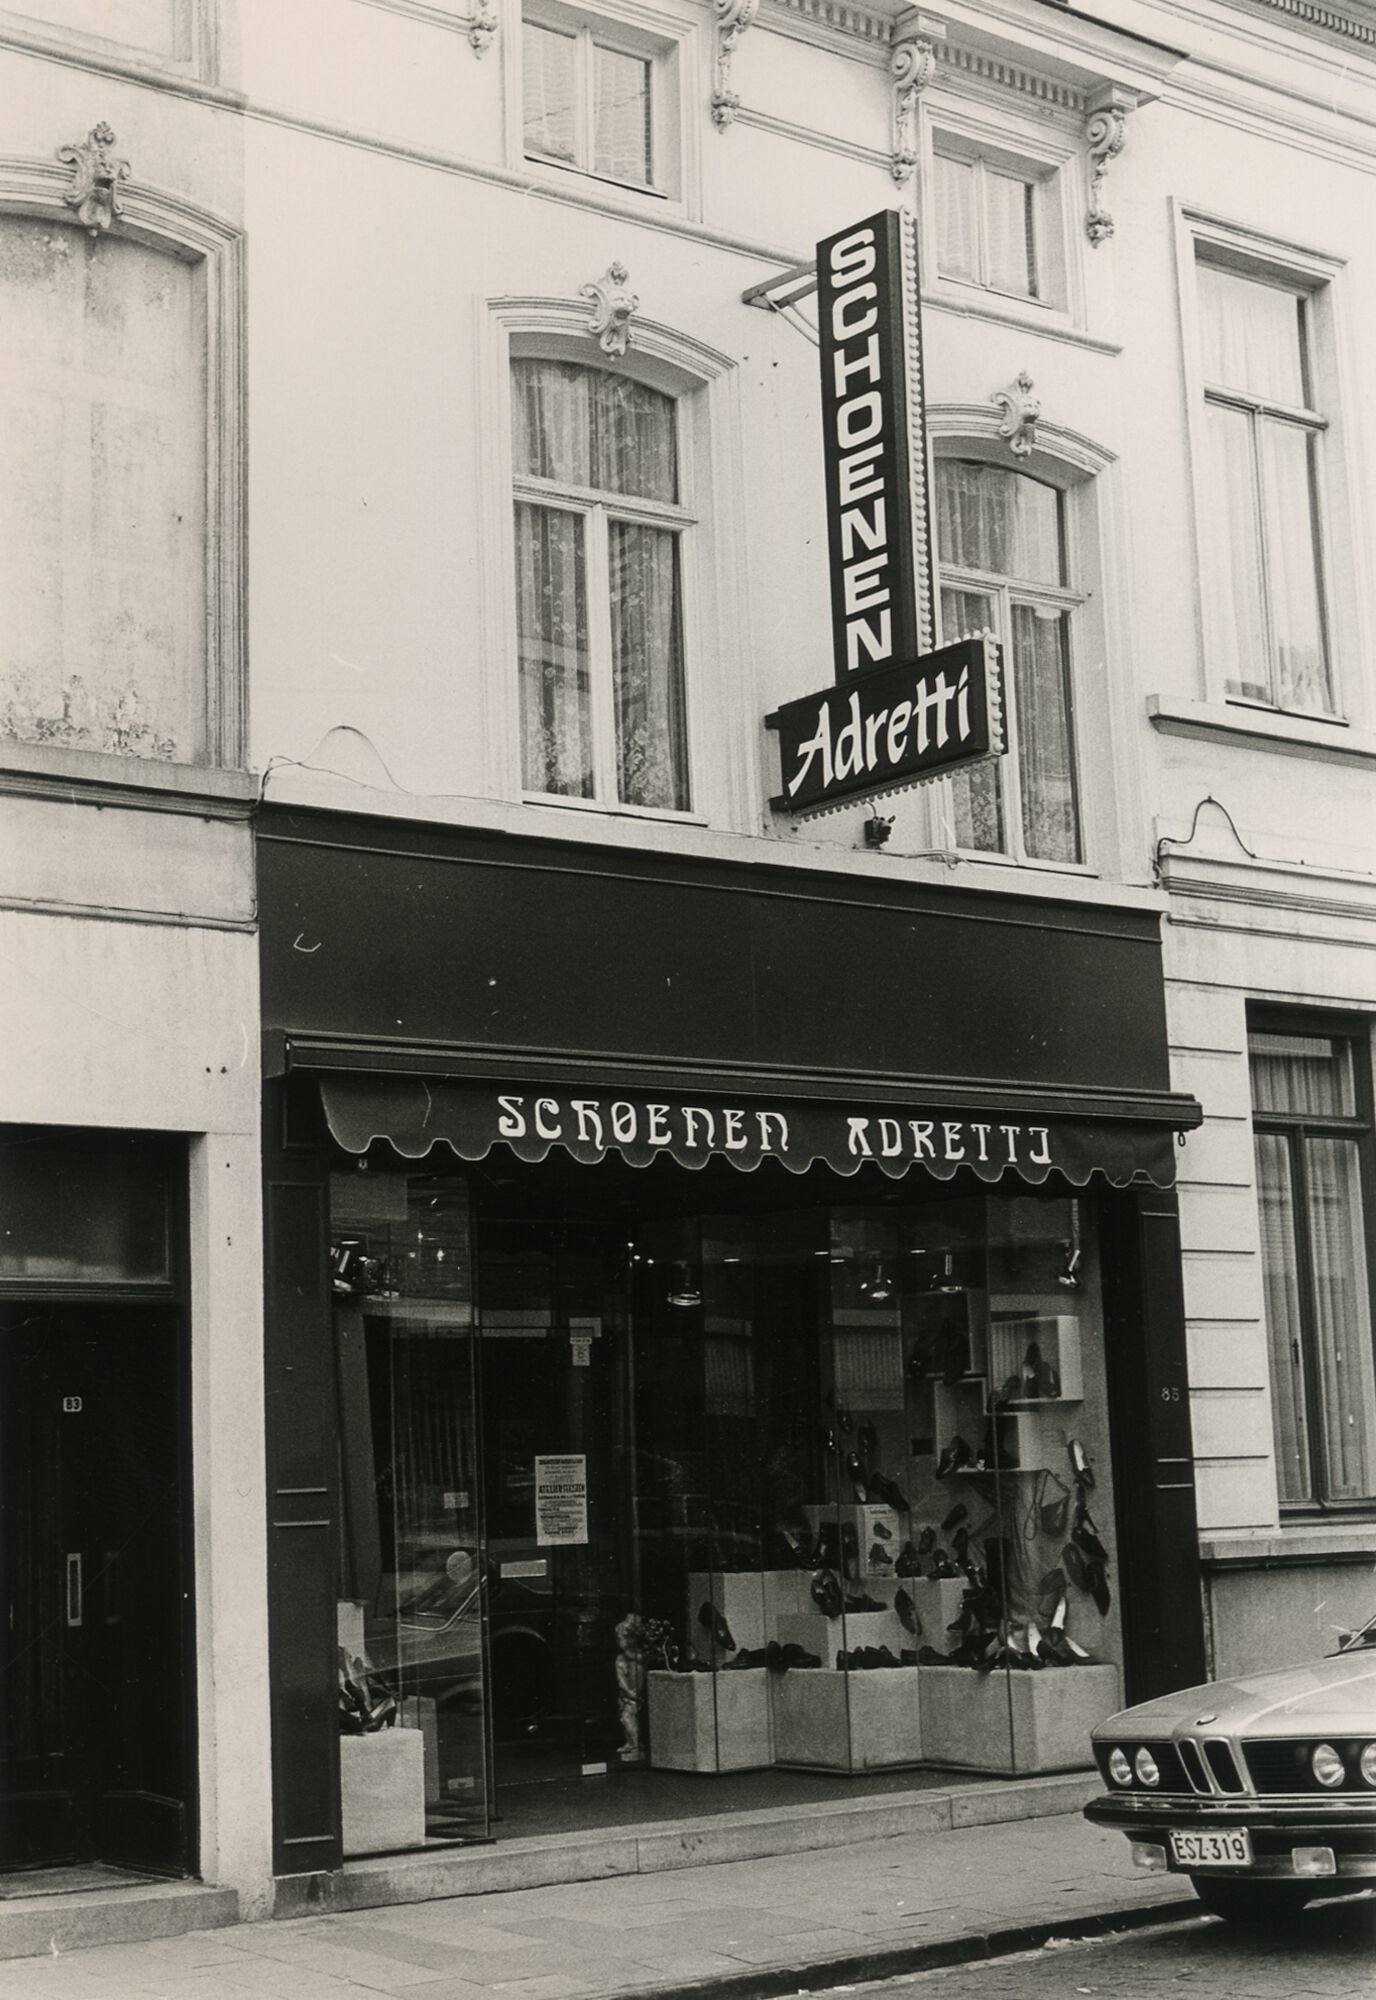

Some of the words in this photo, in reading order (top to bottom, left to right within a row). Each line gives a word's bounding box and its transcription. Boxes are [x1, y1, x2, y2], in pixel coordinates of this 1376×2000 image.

[829, 228, 893, 671] SCHOENEN
[788, 665, 971, 795] Adretti
[497, 1095, 790, 1152] SCHOENEN
